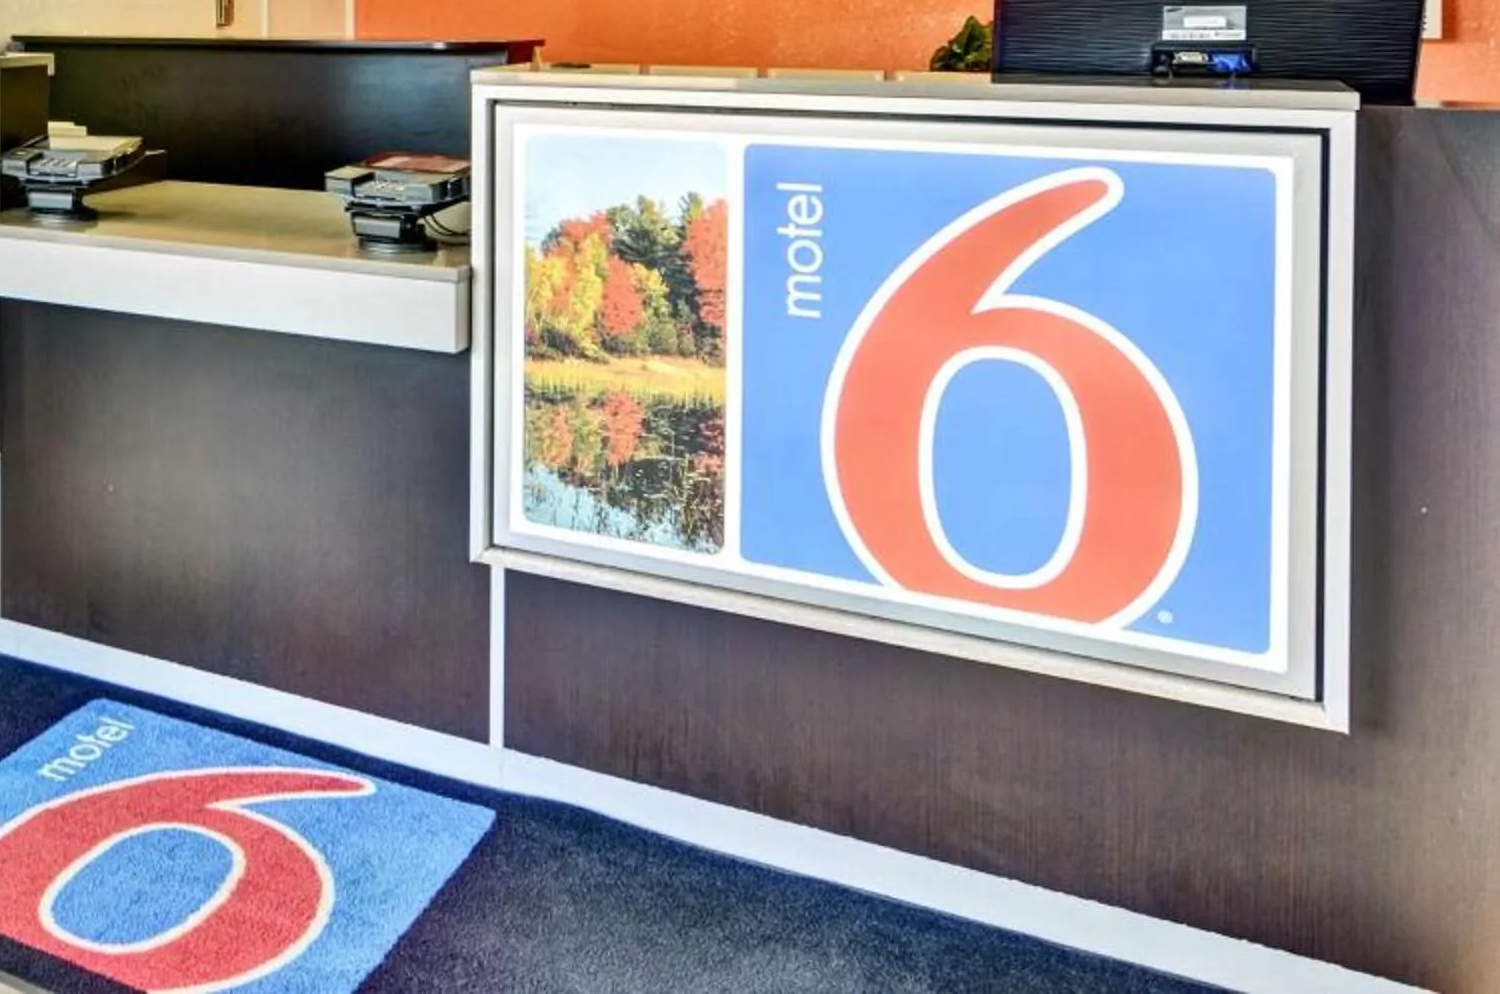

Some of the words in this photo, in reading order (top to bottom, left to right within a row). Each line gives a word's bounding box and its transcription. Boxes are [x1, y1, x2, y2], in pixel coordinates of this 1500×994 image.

[777, 181, 823, 320] motel
[820, 166, 1199, 631] 6
[38, 716, 135, 782] motel
